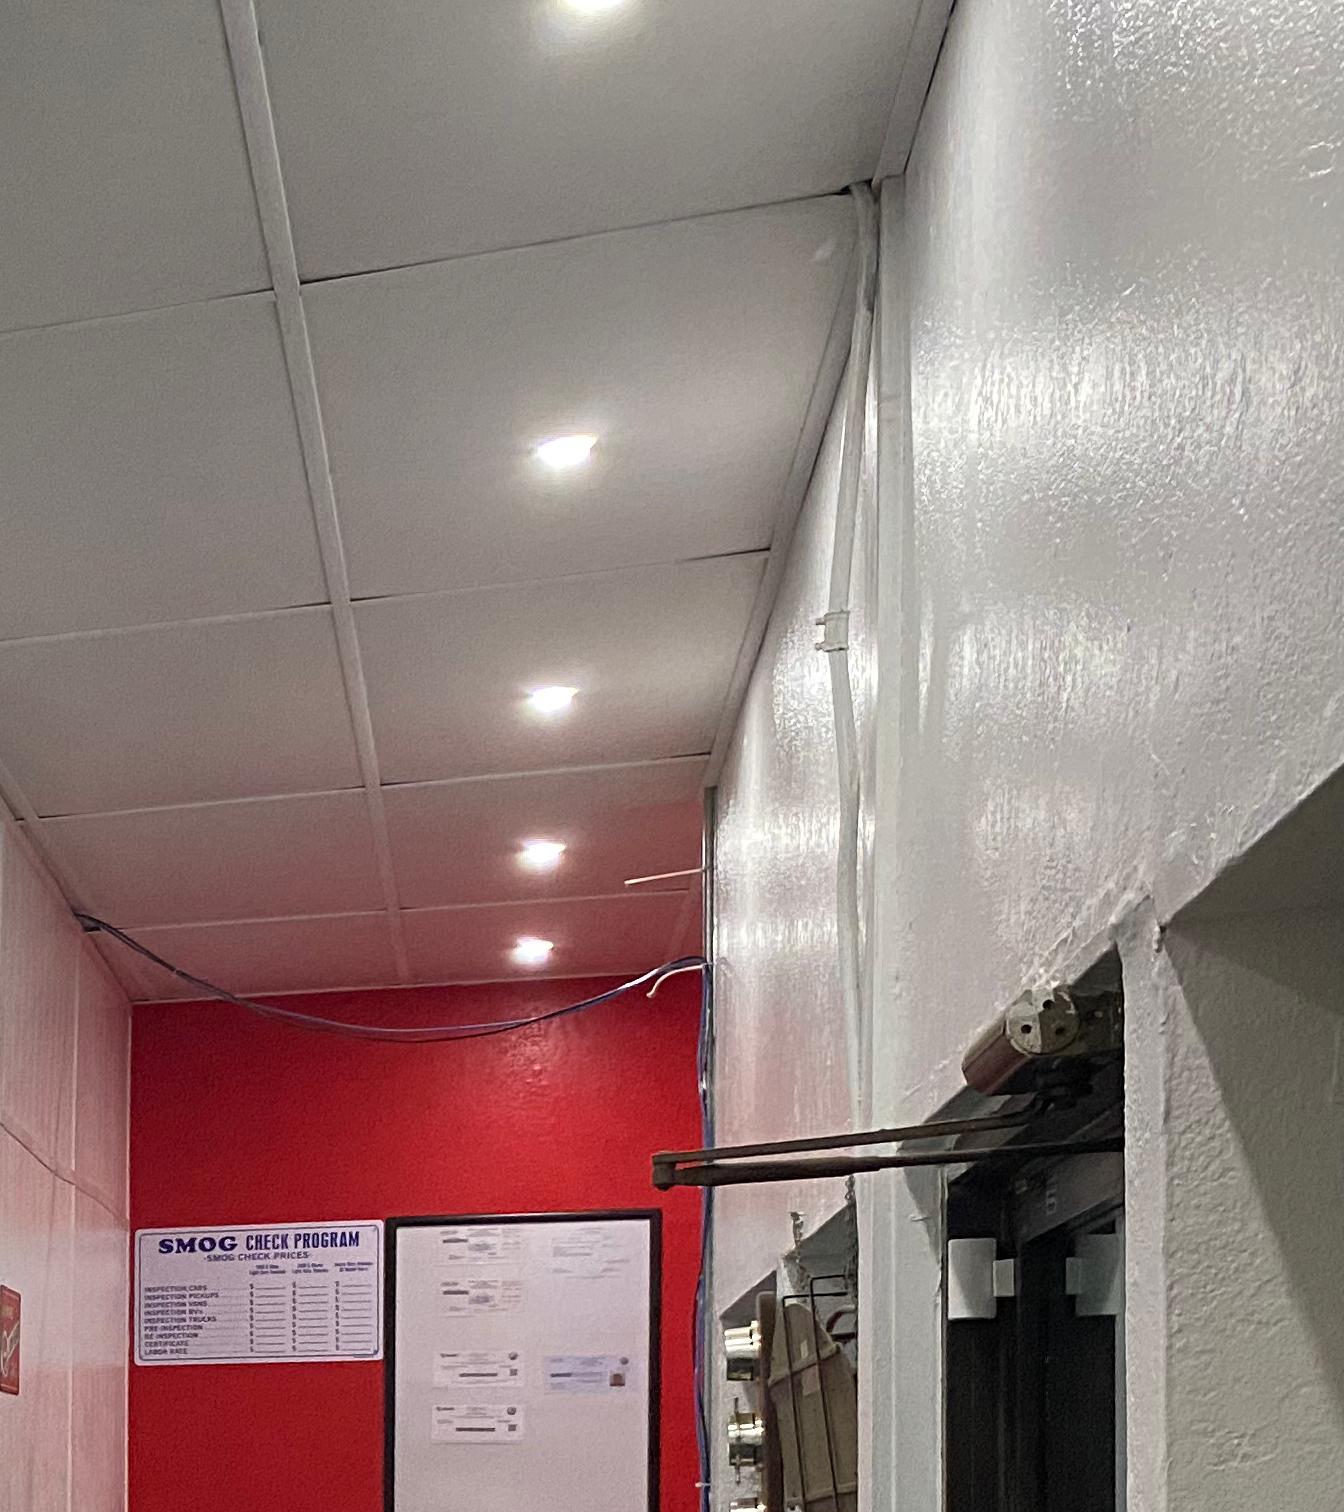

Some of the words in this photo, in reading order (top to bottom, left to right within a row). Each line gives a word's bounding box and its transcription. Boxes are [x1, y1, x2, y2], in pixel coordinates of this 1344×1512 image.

[158, 1236, 238, 1254] SMOG
[245, 1233, 289, 1251] CHECK
[293, 1231, 360, 1250] PROGRAM
[238, 1253, 271, 1261] CHECK
